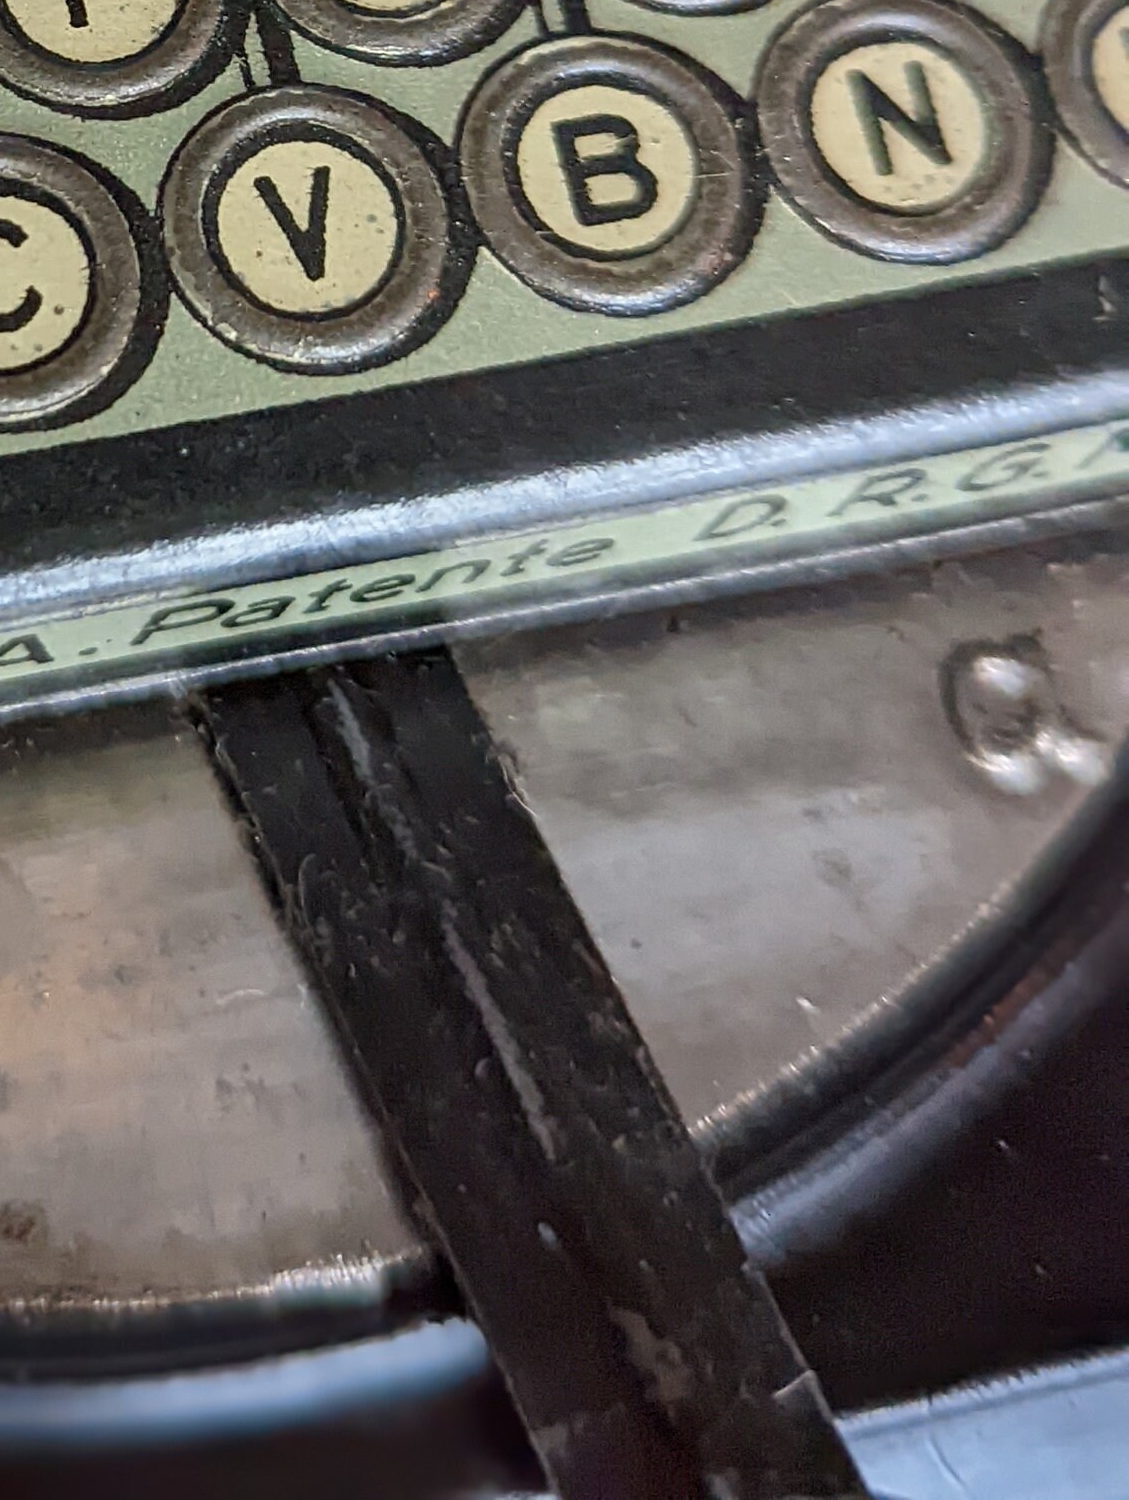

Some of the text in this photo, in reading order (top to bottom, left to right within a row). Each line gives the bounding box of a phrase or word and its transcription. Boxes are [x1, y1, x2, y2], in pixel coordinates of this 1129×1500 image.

[254, 166, 330, 281] V
[552, 114, 658, 227] B
[850, 62, 954, 176] N
[130, 536, 616, 645] Patente
